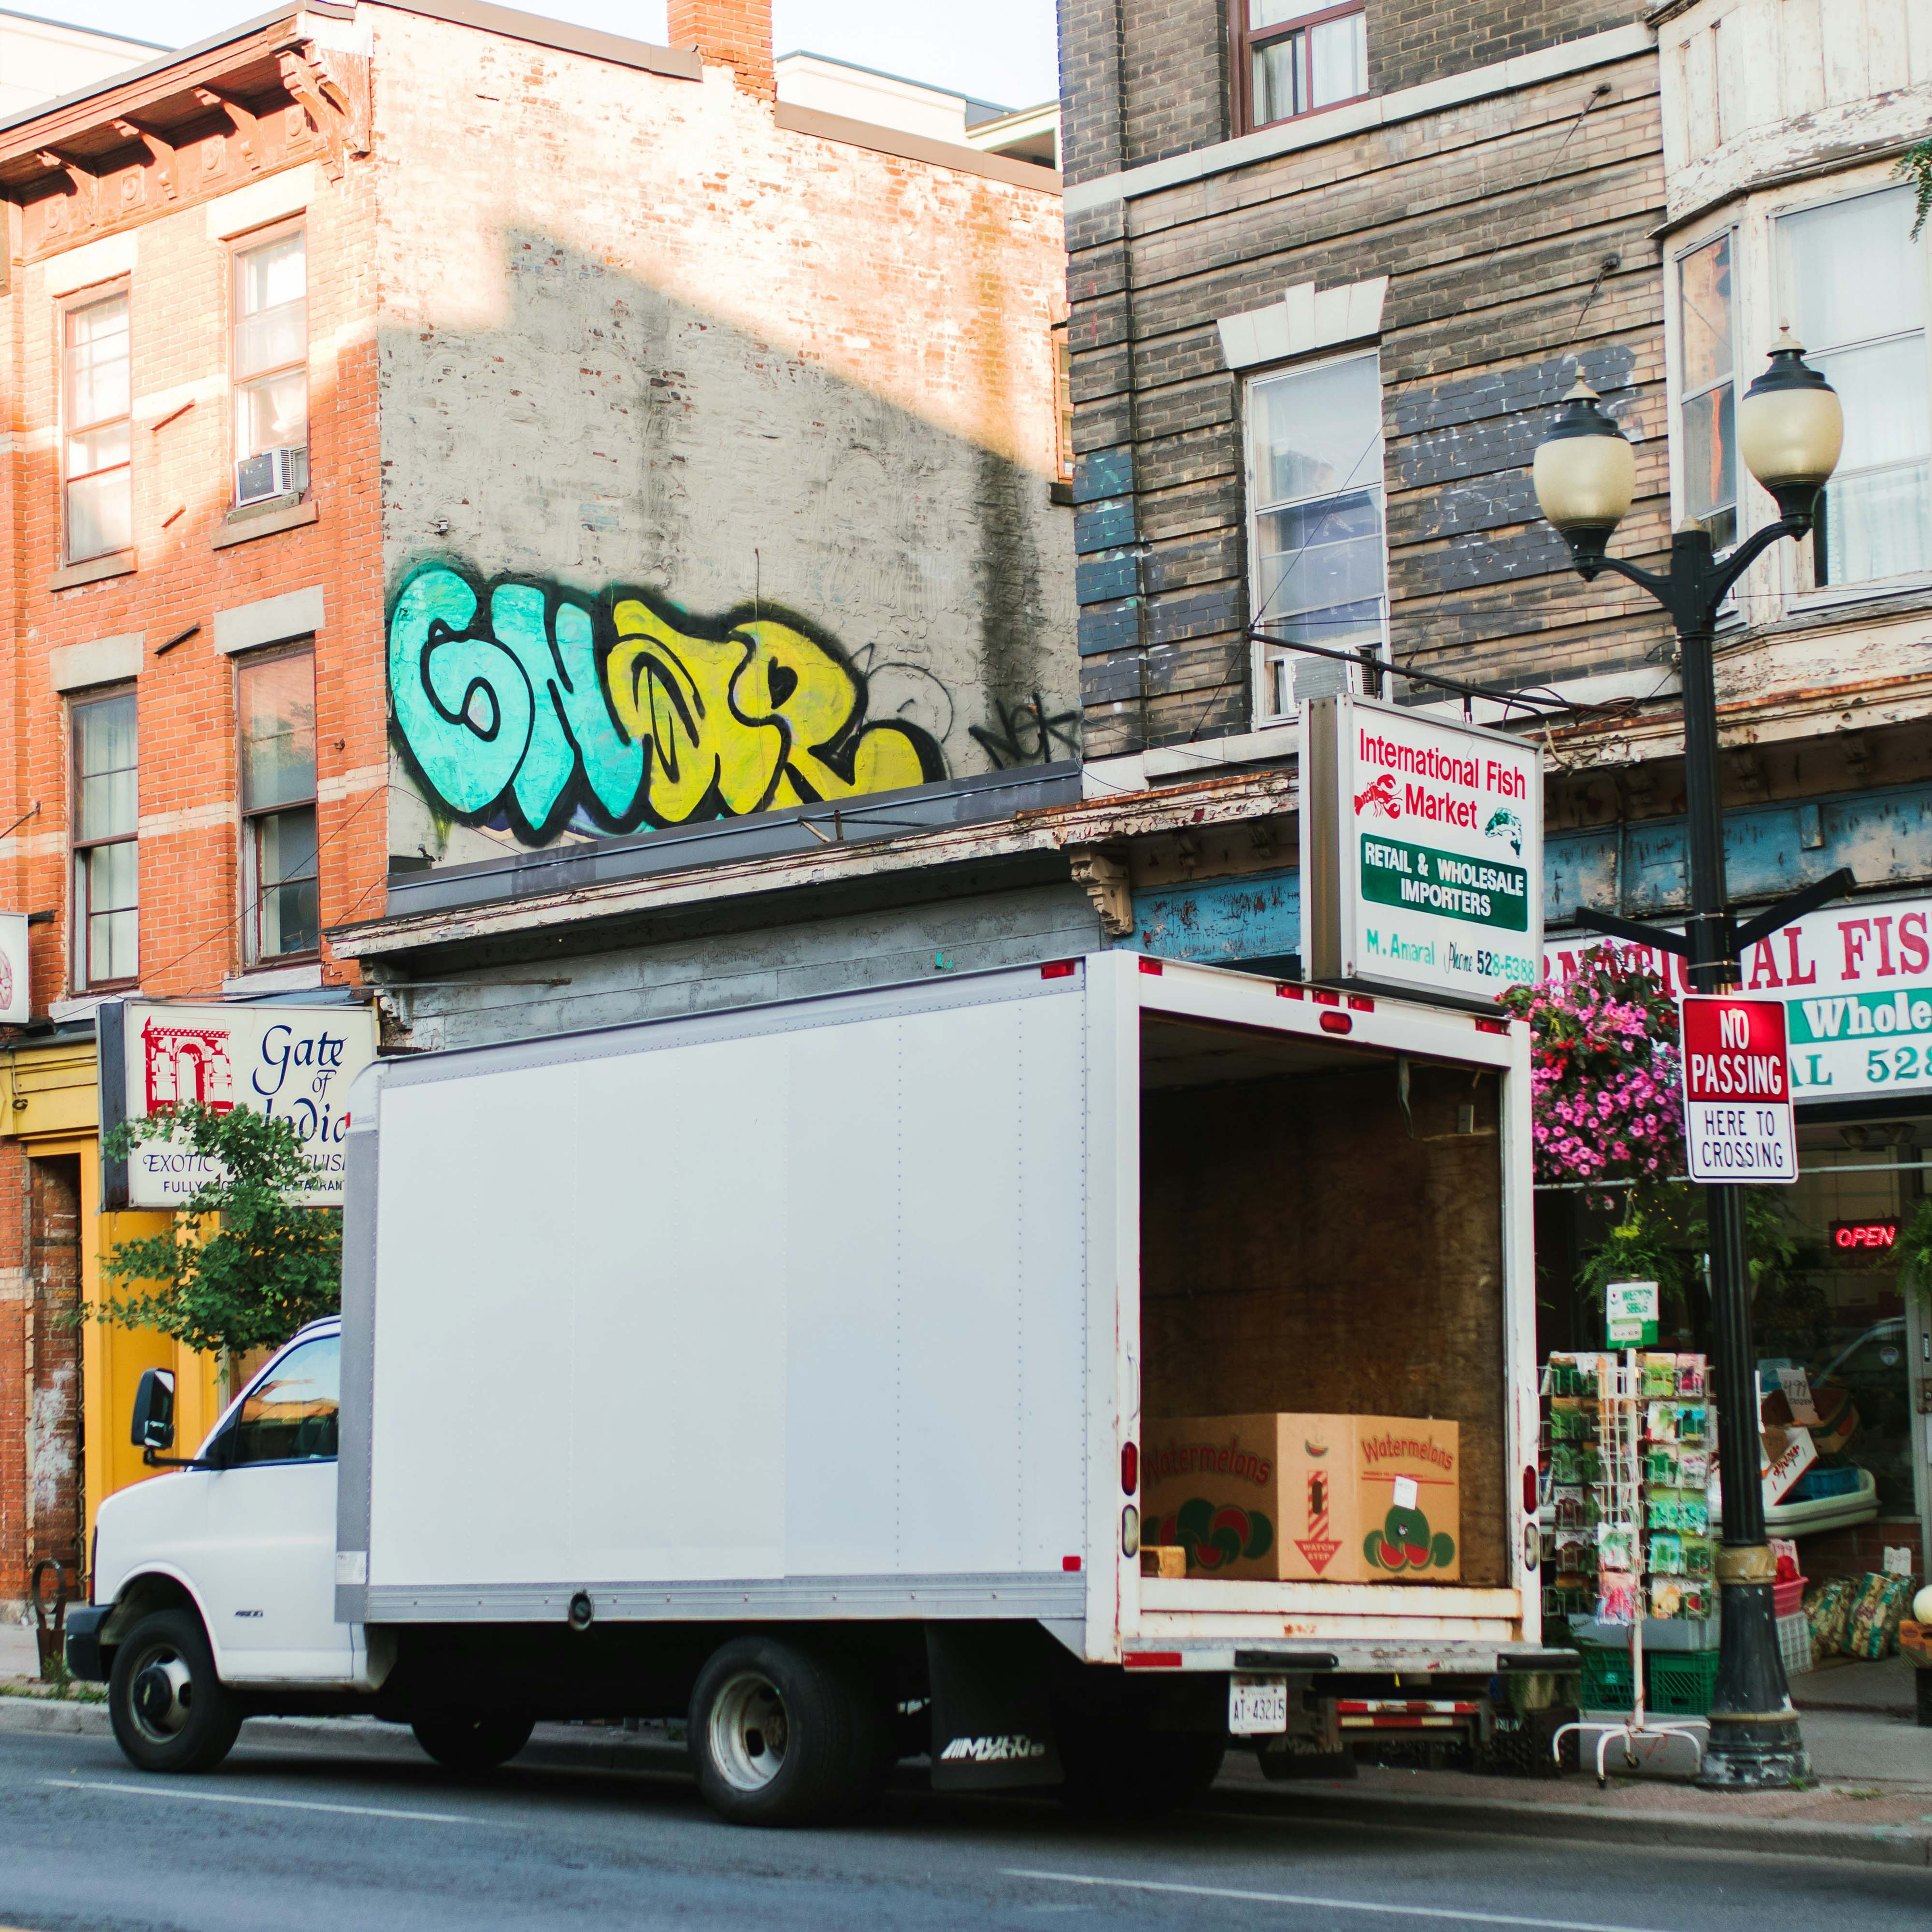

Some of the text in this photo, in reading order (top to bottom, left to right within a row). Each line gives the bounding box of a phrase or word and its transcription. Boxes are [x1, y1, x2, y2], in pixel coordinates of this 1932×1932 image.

[1360, 728, 1525, 800] International Fish
[1406, 783, 1477, 830] Market
[1365, 842, 1524, 897] RETAIL & WHOLESALE
[1401, 878, 1491, 916] IMPORTERS
[1444, 941, 1473, 974] Phone
[1477, 950, 1535, 983] 528-5388
[1838, 912, 1932, 981] FIS
[1720, 1009, 1749, 1050] NO
[1802, 992, 1932, 1038] Whole
[252, 1025, 348, 1096] Gate
[1691, 1053, 1782, 1095] PASSING
[1790, 1054, 1833, 1088] L
[1705, 1110, 1775, 1137] HERE TO
[143, 1154, 215, 1173] EXOTIC
[1702, 1141, 1783, 1168] CROSSING
[164, 1181, 201, 1192] FULLY
[1836, 1225, 1896, 1248] OPEN
[1140, 1433, 1273, 1488] Watermelons
[1360, 1432, 1454, 1471] Watermelons
[1302, 1543, 1335, 1551] WATCH
[1308, 1552, 1330, 1560] STEP
